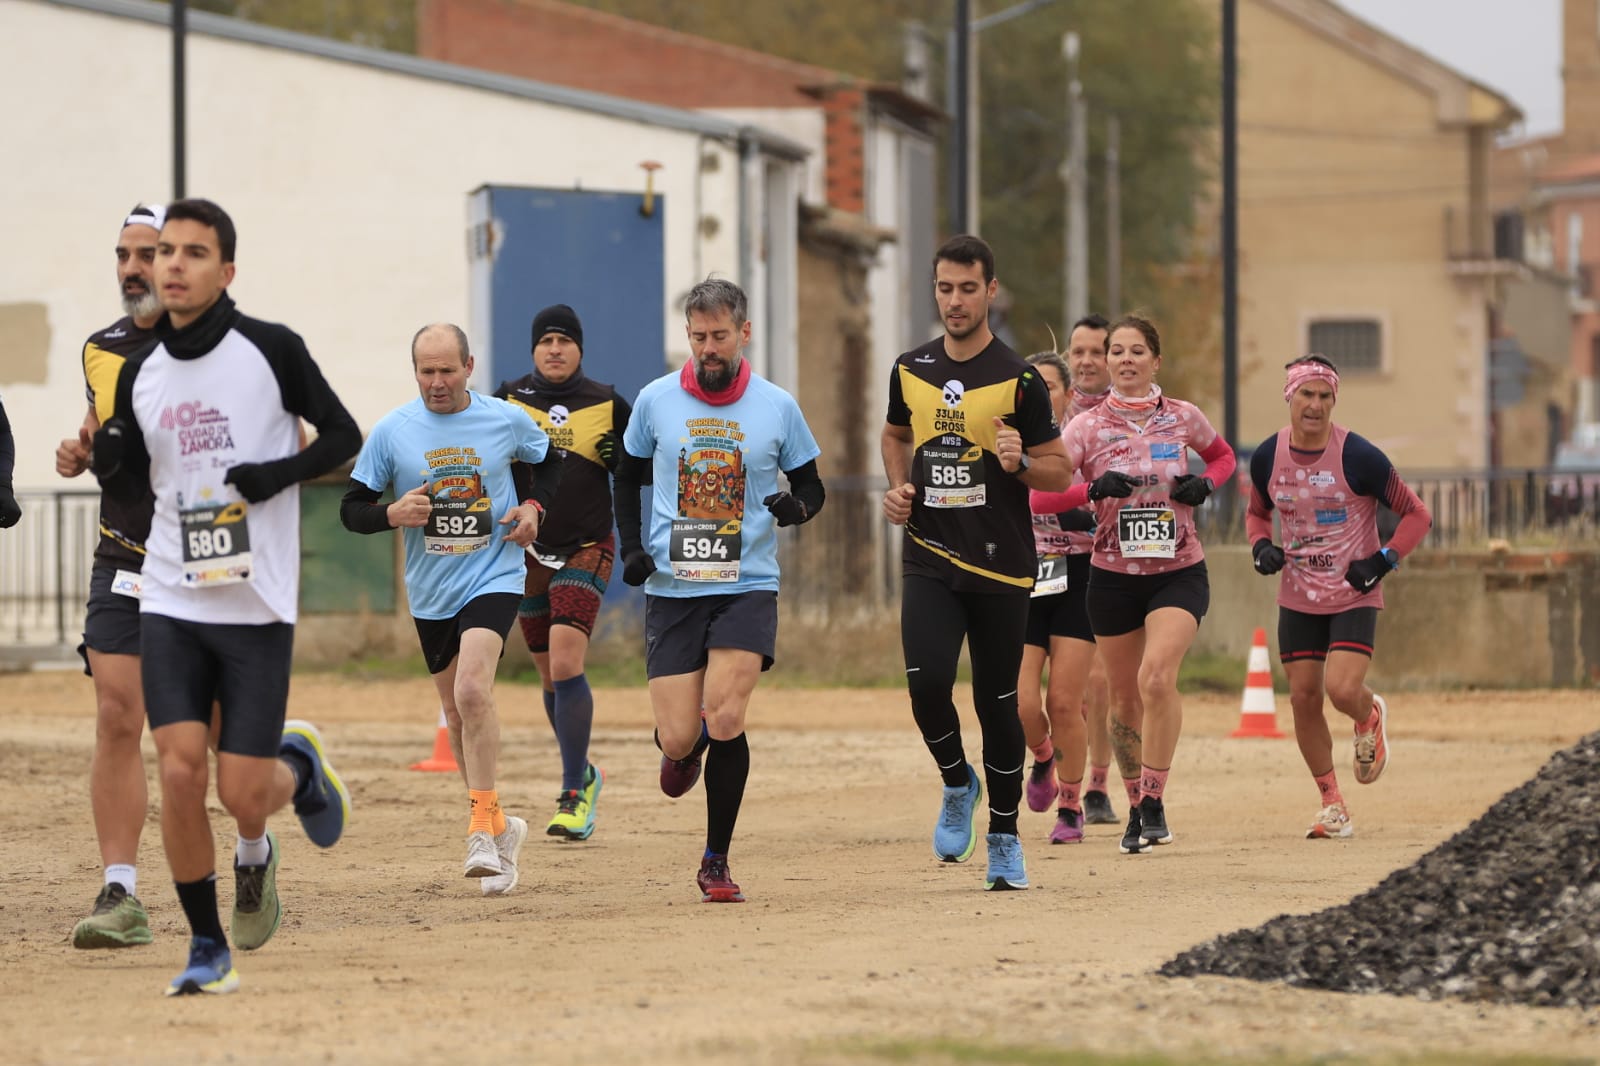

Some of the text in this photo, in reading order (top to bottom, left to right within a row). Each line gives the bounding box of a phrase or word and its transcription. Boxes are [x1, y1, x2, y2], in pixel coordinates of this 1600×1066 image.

[686, 417, 725, 428] CARRERA
[934, 421, 965, 433] CROSS
[690, 427, 727, 438] ROSCON
[181, 435, 234, 456] ZAMORA
[941, 436, 955, 446] AVS
[424, 447, 462, 460] CARRERA
[700, 450, 726, 461] META
[429, 456, 466, 468] ROSCON
[931, 465, 972, 486] 585
[442, 477, 466, 488] META
[927, 494, 984, 505] JOMISAGA
[435, 515, 479, 536] 592
[698, 523, 718, 532] CROSS
[1126, 520, 1170, 541] 1053
[188, 527, 233, 559] 580
[427, 541, 489, 553] JOMISAGA
[682, 537, 728, 560] 594
[1125, 543, 1171, 553] JOMISAGA
[1308, 554, 1334, 568] MSC
[675, 568, 738, 579] JOMISAGA
